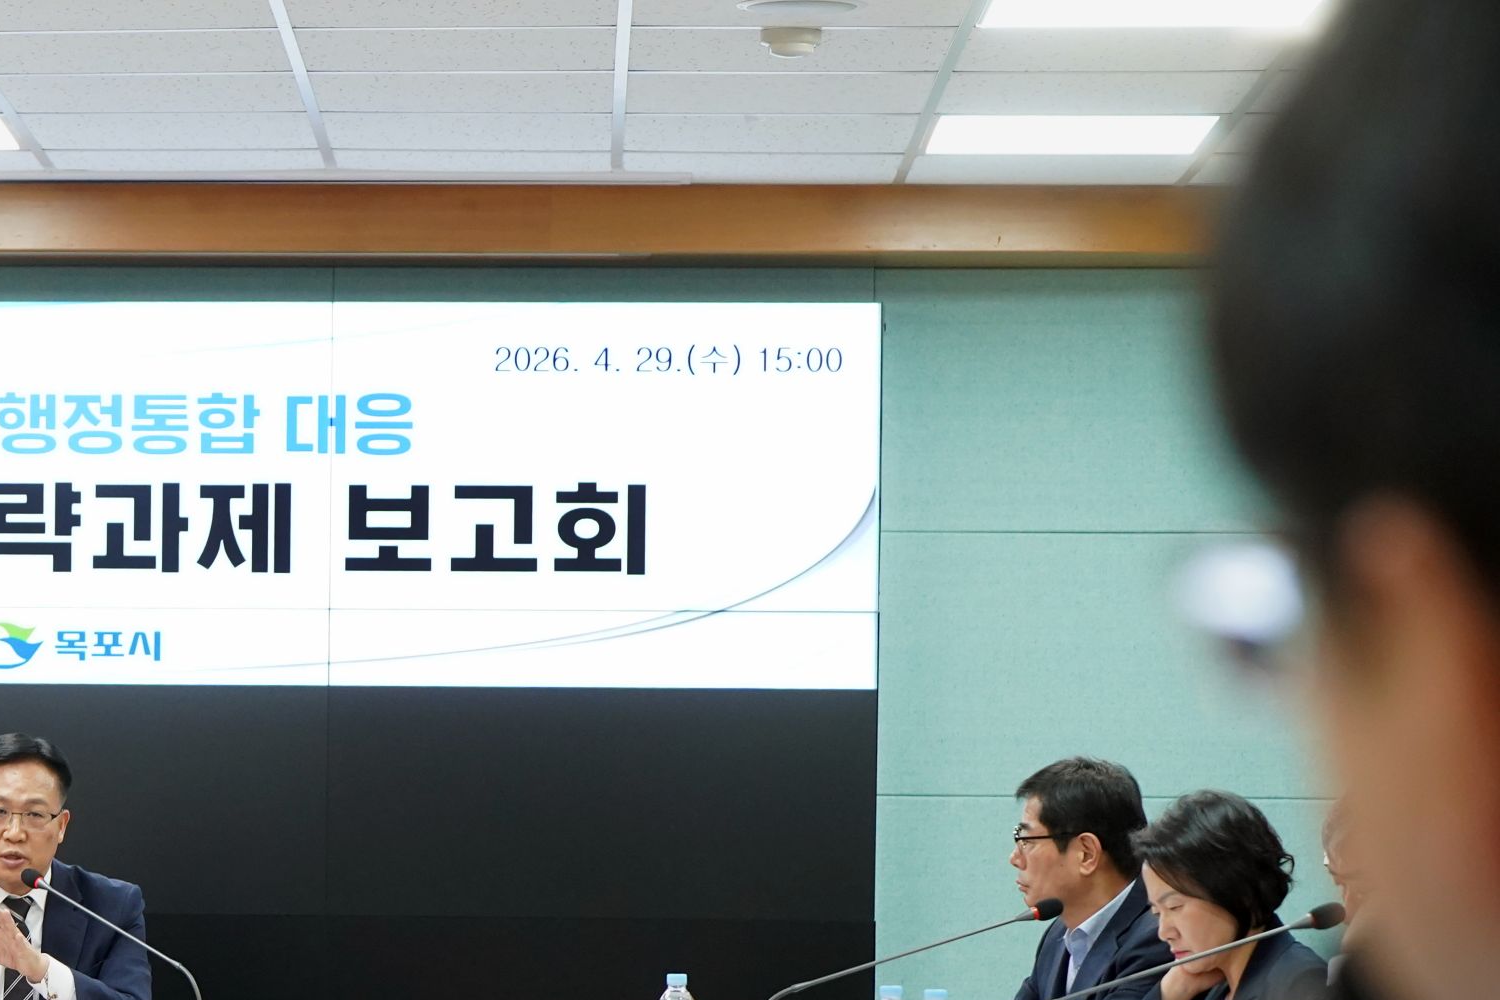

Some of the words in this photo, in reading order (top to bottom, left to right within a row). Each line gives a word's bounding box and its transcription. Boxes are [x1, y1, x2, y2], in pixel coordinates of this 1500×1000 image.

[494, 346, 579, 373] 2026.
[594, 346, 620, 373] 4.
[636, 344, 742, 376] 29.(수)
[760, 346, 843, 373] 15:00
[285, 392, 414, 457] 대응
[344, 482, 647, 576] 보고회
[55, 630, 161, 662] 목포시
